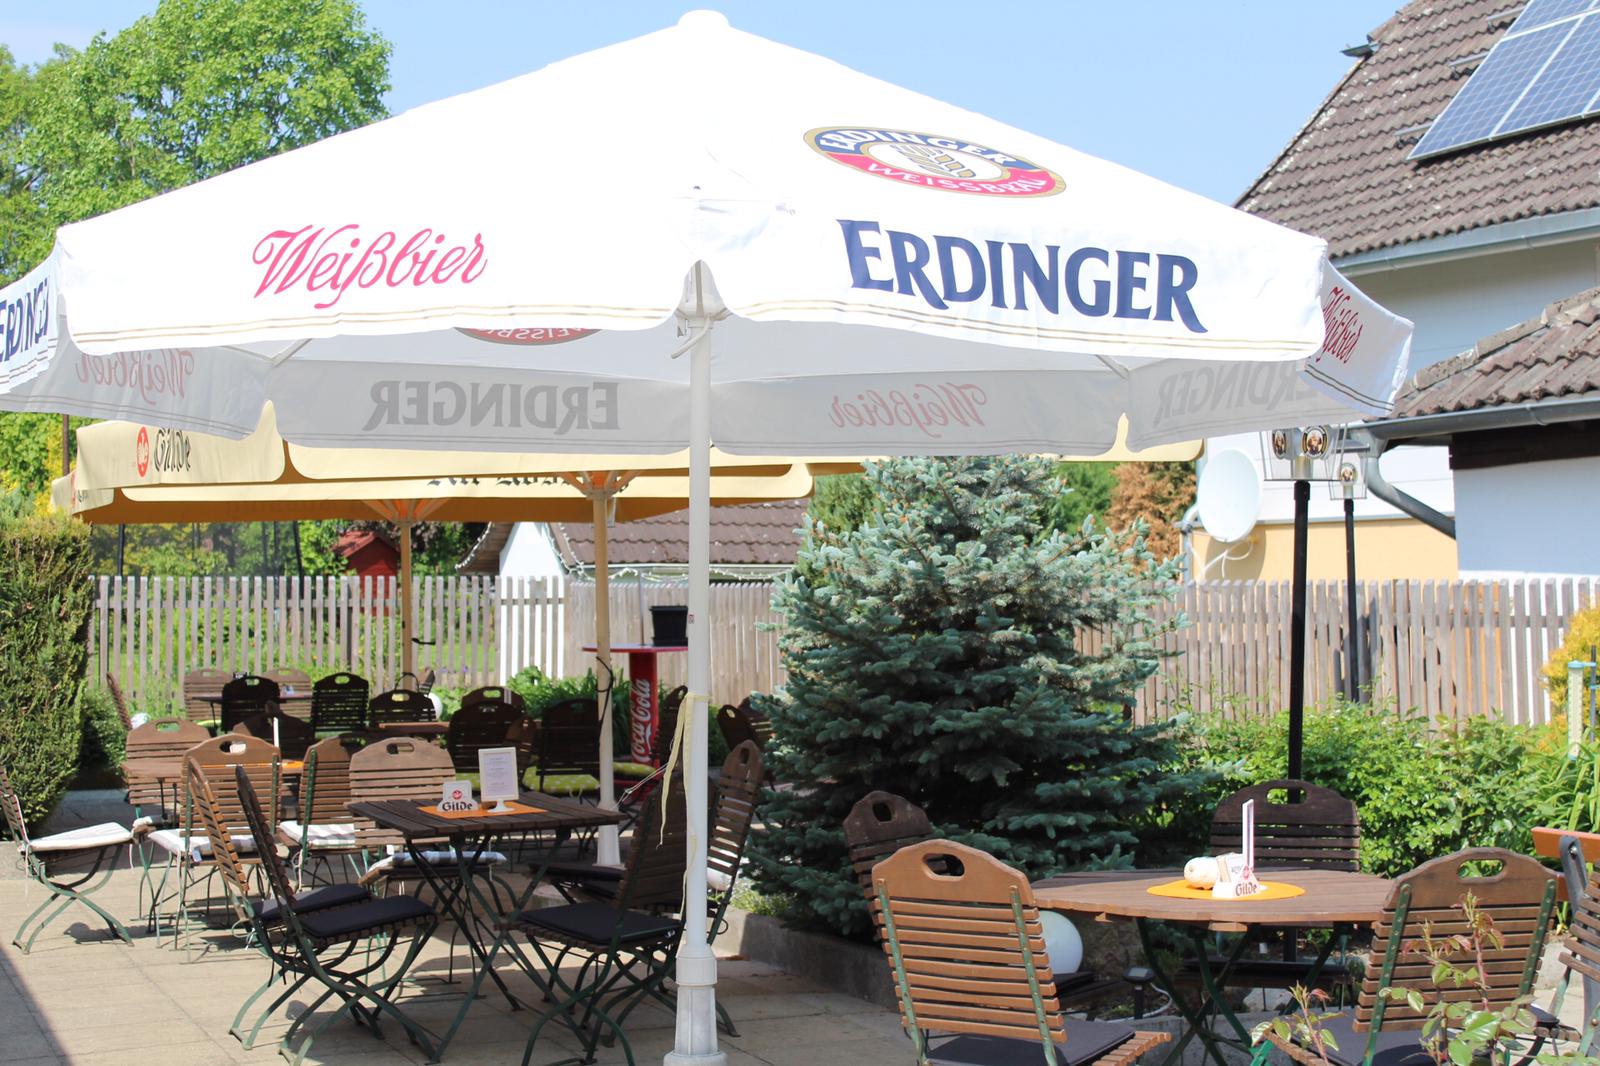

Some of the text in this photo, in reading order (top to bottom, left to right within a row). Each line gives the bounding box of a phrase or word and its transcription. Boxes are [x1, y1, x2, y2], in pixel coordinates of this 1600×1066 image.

[820, 129, 1017, 164] ERDINGER
[253, 223, 488, 309] Weißbier
[836, 219, 1209, 334] ERDINGER
[442, 801, 473, 812] Gilde
[1235, 882, 1258, 897] Gilde
